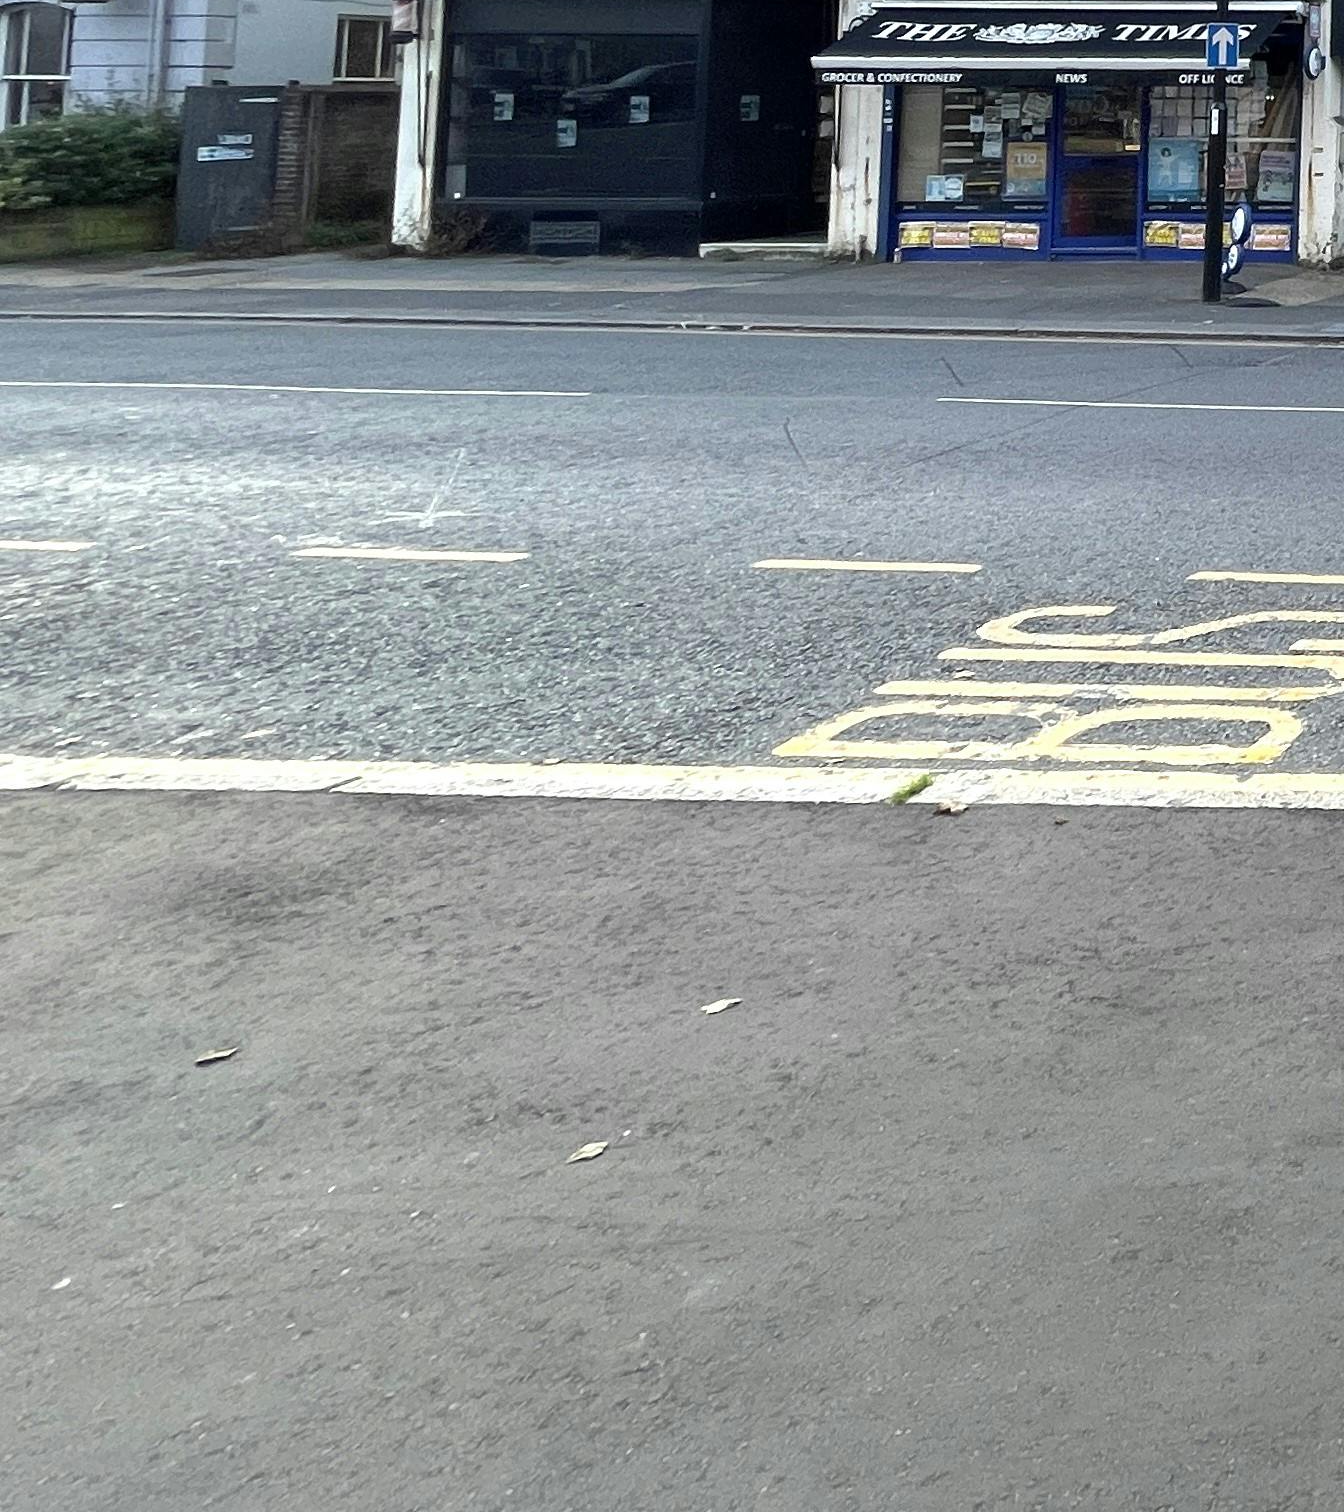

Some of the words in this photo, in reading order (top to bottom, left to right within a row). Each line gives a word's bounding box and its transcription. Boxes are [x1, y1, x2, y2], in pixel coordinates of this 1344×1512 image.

[872, 21, 977, 42] THE
[1112, 24, 1257, 41] TIMS
[821, 73, 864, 83] GROCER
[866, 73, 875, 83] &
[877, 73, 963, 83] CONFECTIONERY
[1055, 73, 1088, 83] NEWS
[1179, 74, 1200, 84] OFF
